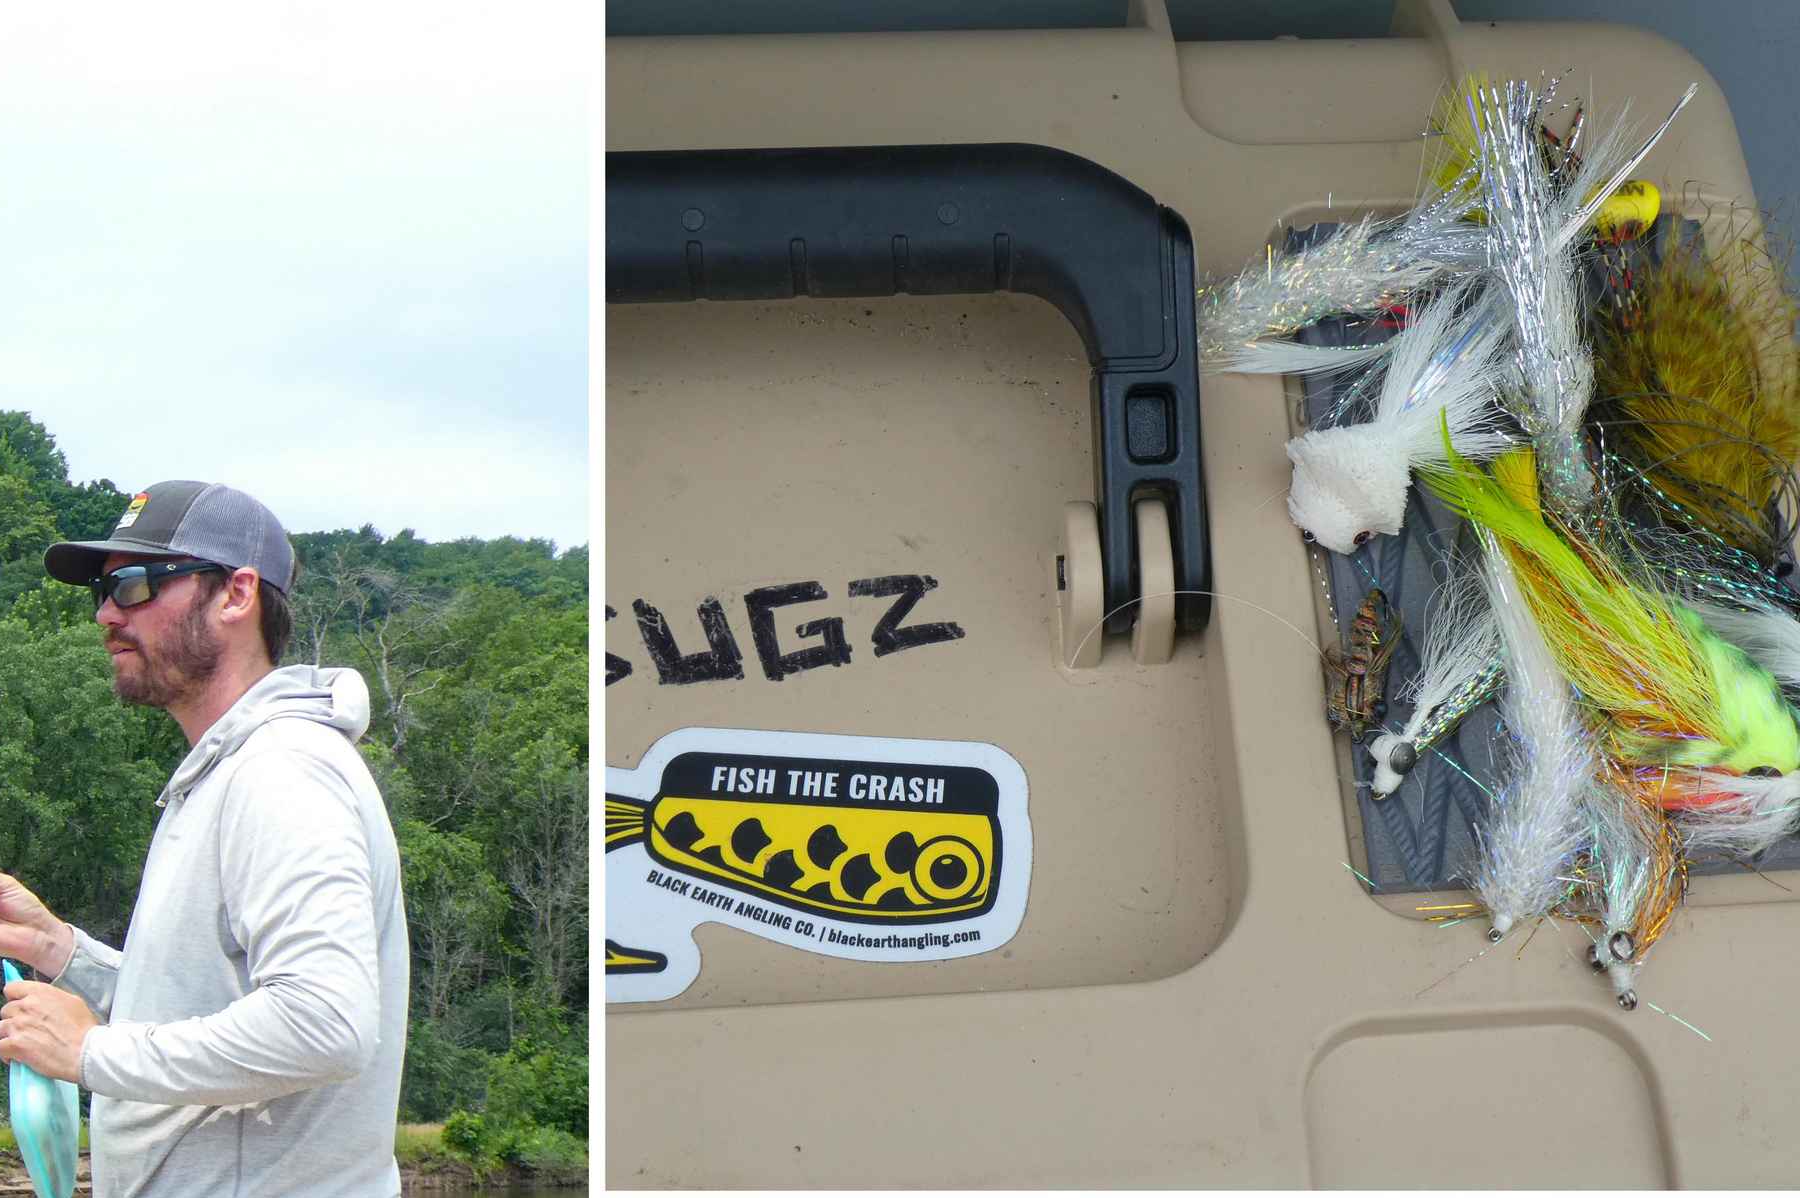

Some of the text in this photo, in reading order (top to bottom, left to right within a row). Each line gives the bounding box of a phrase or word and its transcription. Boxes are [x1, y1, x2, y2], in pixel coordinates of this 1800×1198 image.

[711, 766, 945, 804] FISH THE CRASH
[646, 869, 692, 897] BLACK
[690, 886, 734, 913] EARTH
[734, 902, 792, 930] ANGLING
[794, 919, 816, 938] CO.
[828, 928, 981, 950] blackearthangling.com
